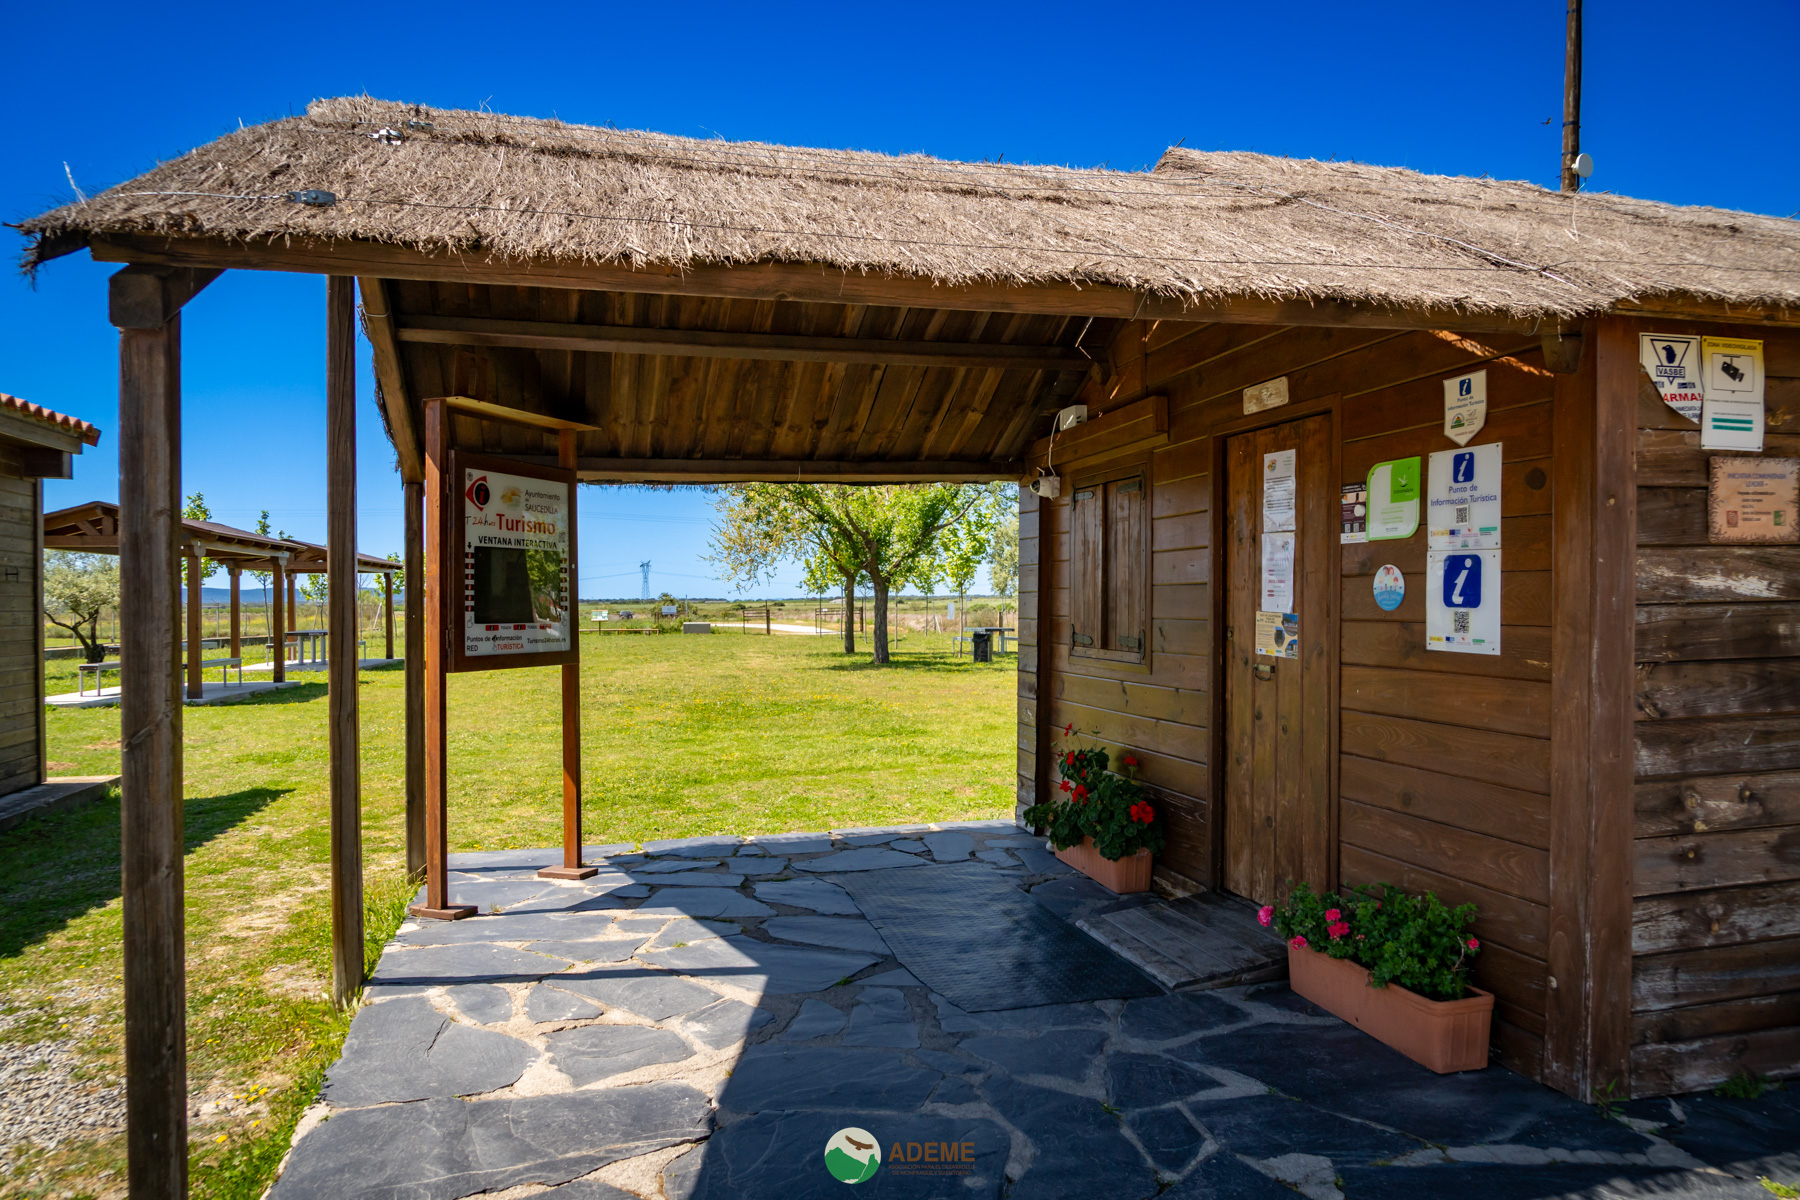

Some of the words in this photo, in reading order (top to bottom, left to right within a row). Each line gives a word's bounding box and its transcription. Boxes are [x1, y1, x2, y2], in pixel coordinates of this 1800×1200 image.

[1658, 367, 1684, 376] VASBE
[1448, 486, 1468, 494] Punto
[524, 490, 560, 501] Ayuntamiento
[1430, 497, 1468, 506] Información
[1469, 494, 1497, 502] Turística
[524, 504, 558, 514] SAUCEDILLA
[496, 513, 556, 534] Turismo
[478, 536, 512, 546] VENTANA
[514, 538, 558, 549] INTERACTIVA
[496, 642, 524, 650] TURÍSTICA
